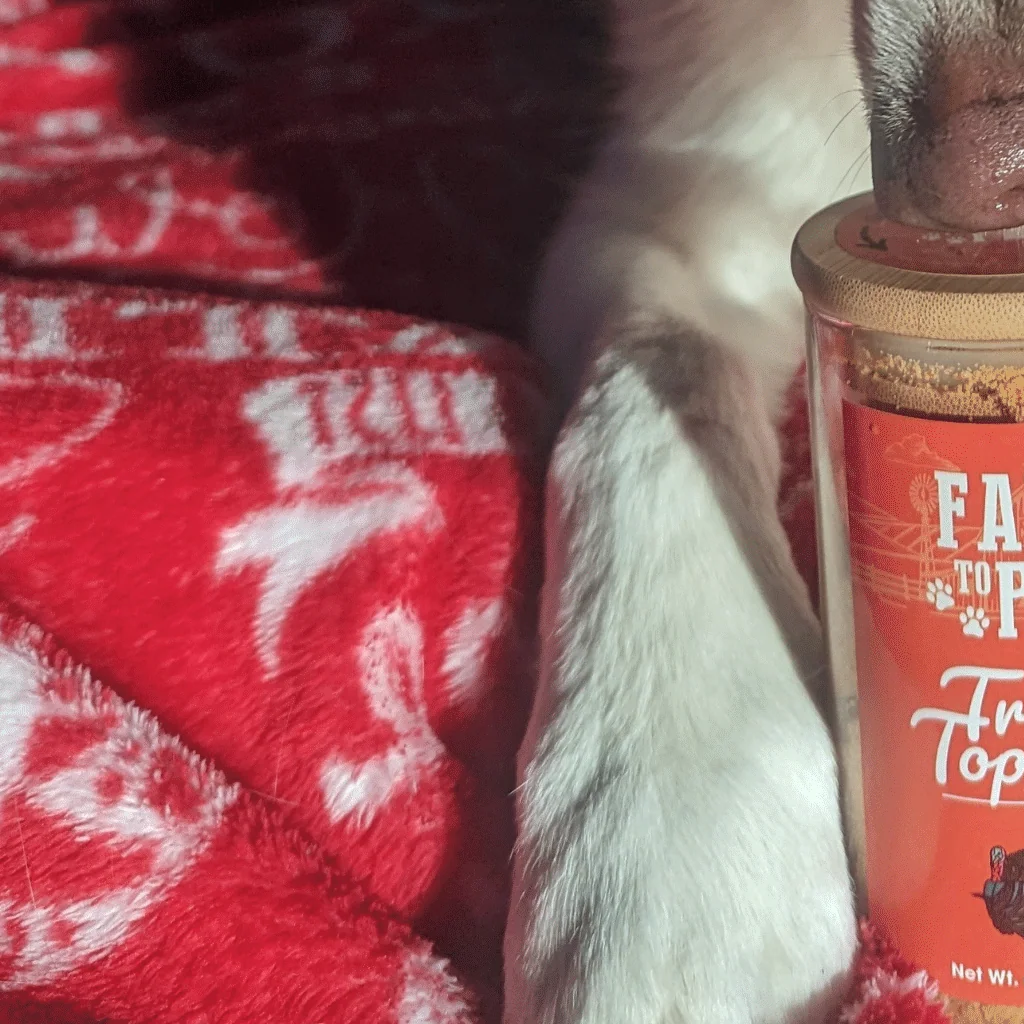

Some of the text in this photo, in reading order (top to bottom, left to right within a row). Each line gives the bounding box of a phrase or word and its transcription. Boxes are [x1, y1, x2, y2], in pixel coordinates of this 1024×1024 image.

[953, 558, 992, 596] TO
[951, 960, 983, 983] Net
[987, 967, 1019, 987] Wt.
